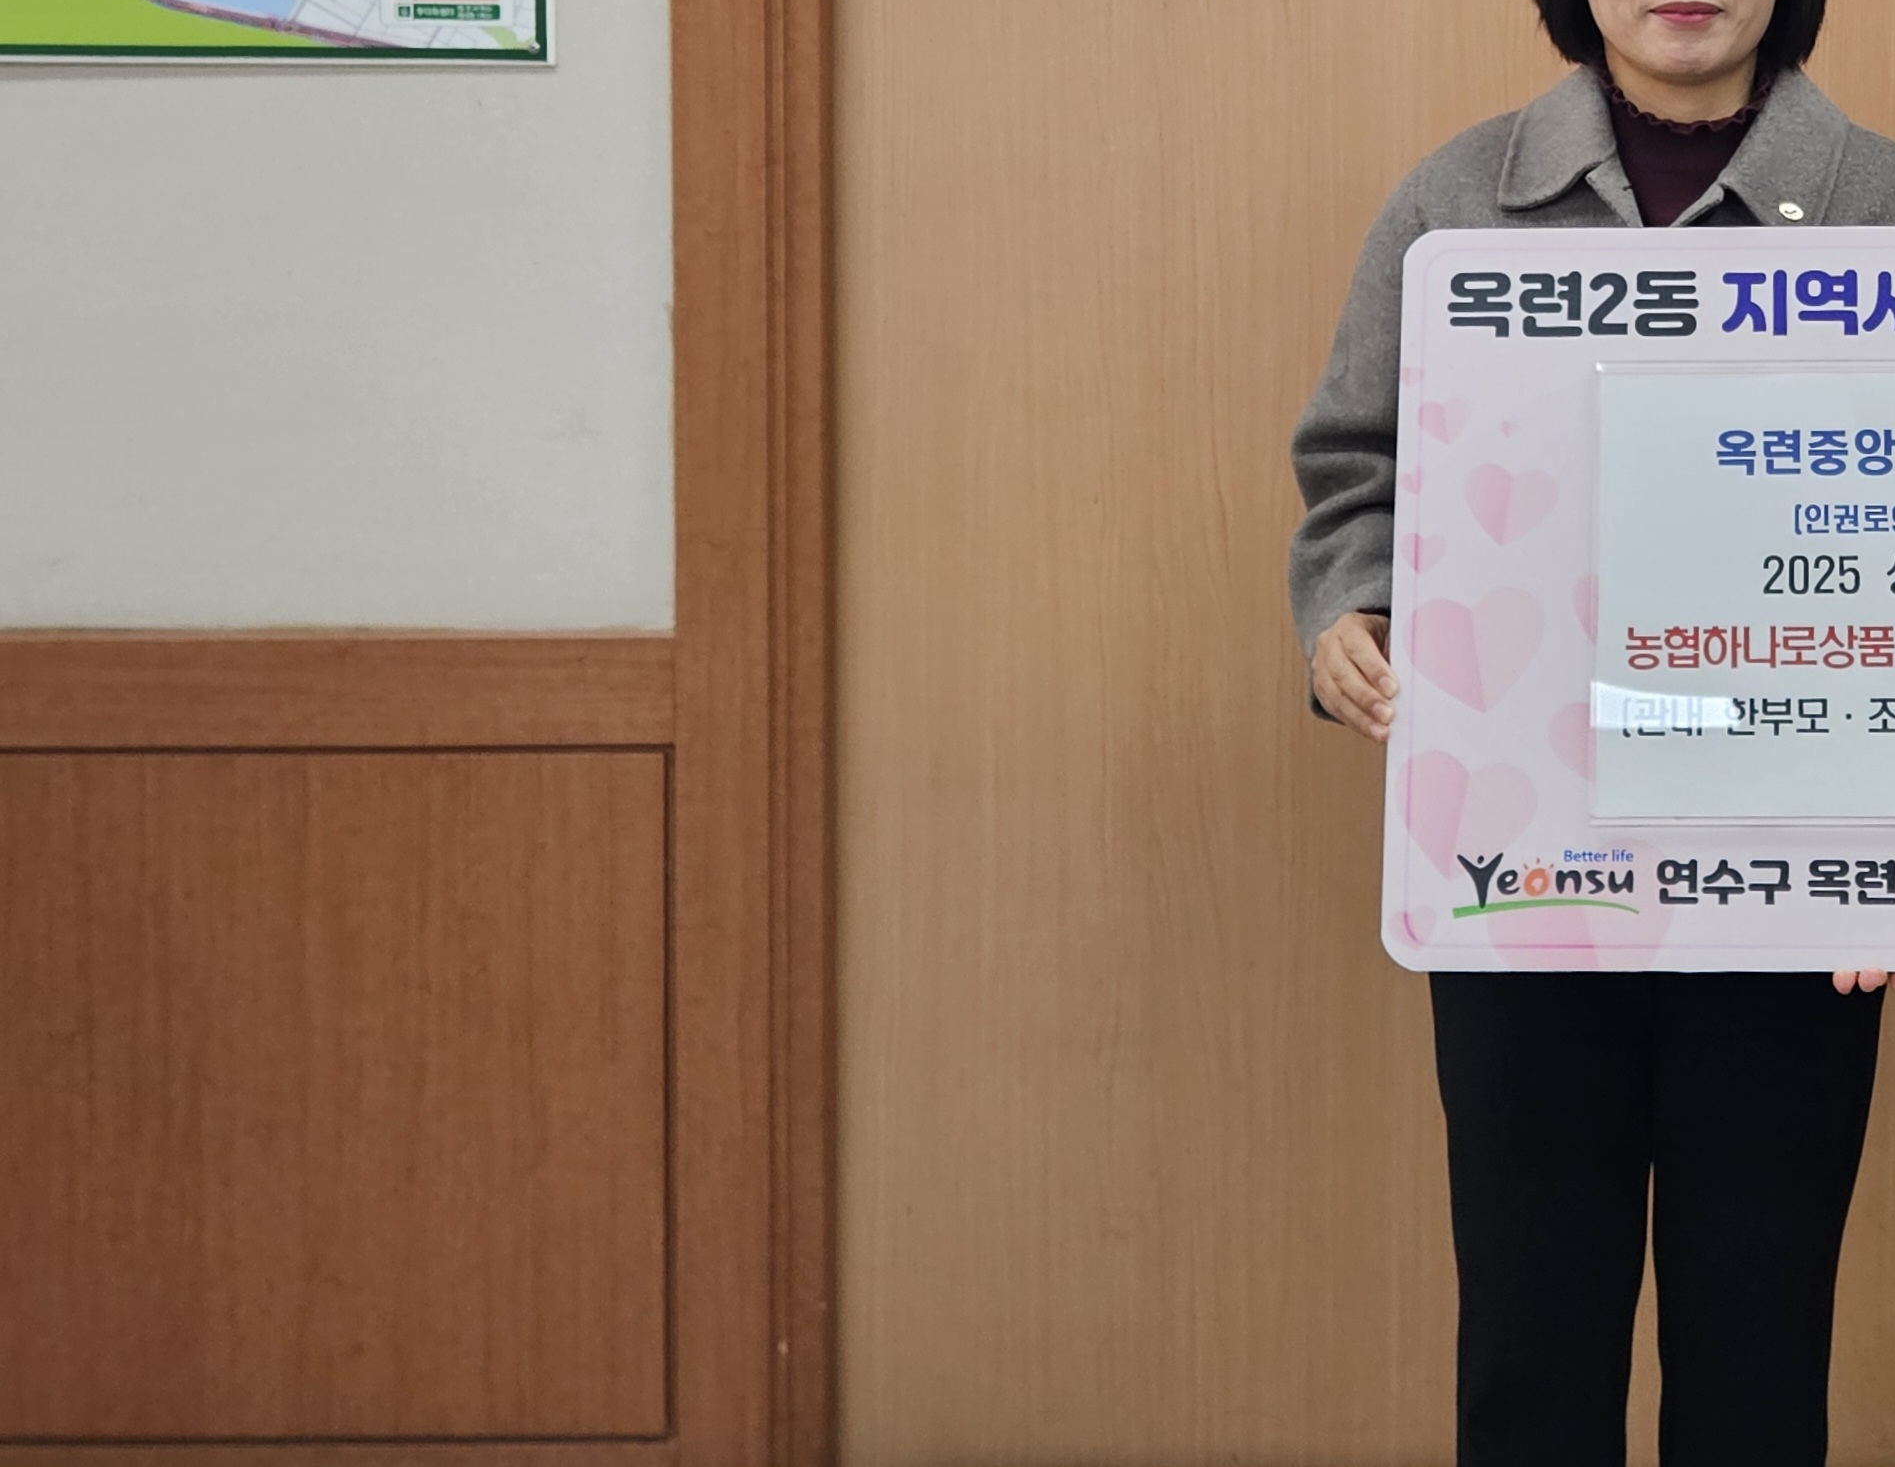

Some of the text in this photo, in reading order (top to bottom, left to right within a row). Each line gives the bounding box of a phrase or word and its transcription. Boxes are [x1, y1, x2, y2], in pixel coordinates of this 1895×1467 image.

[1447, 270, 1700, 338] 옥련2동
[1762, 554, 1861, 595] 2025
[1564, 848, 1635, 864] Better life
[1456, 852, 1635, 909] Yeonsu
[1656, 858, 1793, 906] 연수구
